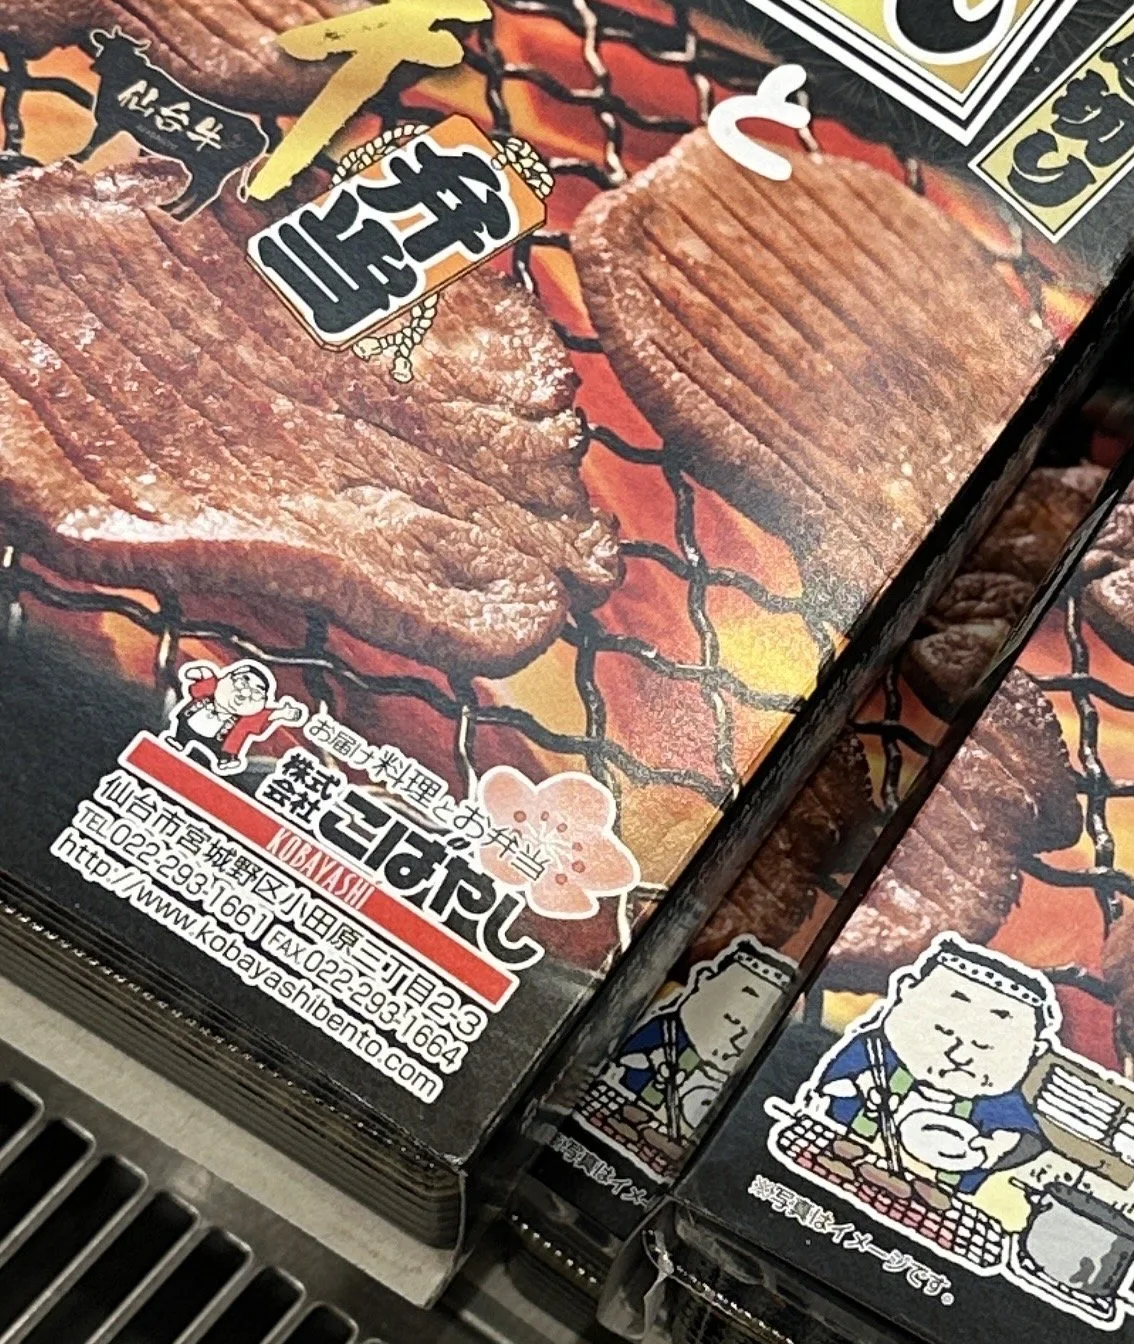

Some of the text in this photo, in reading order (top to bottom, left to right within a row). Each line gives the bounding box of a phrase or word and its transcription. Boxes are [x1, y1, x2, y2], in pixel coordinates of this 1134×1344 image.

[116, 79, 225, 152] 仙台牛
[708, 63, 812, 182] と
[257, 135, 512, 338] 弁当
[265, 826, 378, 910] KOBAYASHI
[310, 718, 552, 881] お届け料理とお弁当
[319, 788, 543, 968] こばやし
[56, 836, 440, 1099] http://www.kobayashibento.com
[101, 776, 483, 1037] 仙台市宮城野区小田原三丁目2-3
[748, 1176, 955, 1307] ※写真はイメージです。
